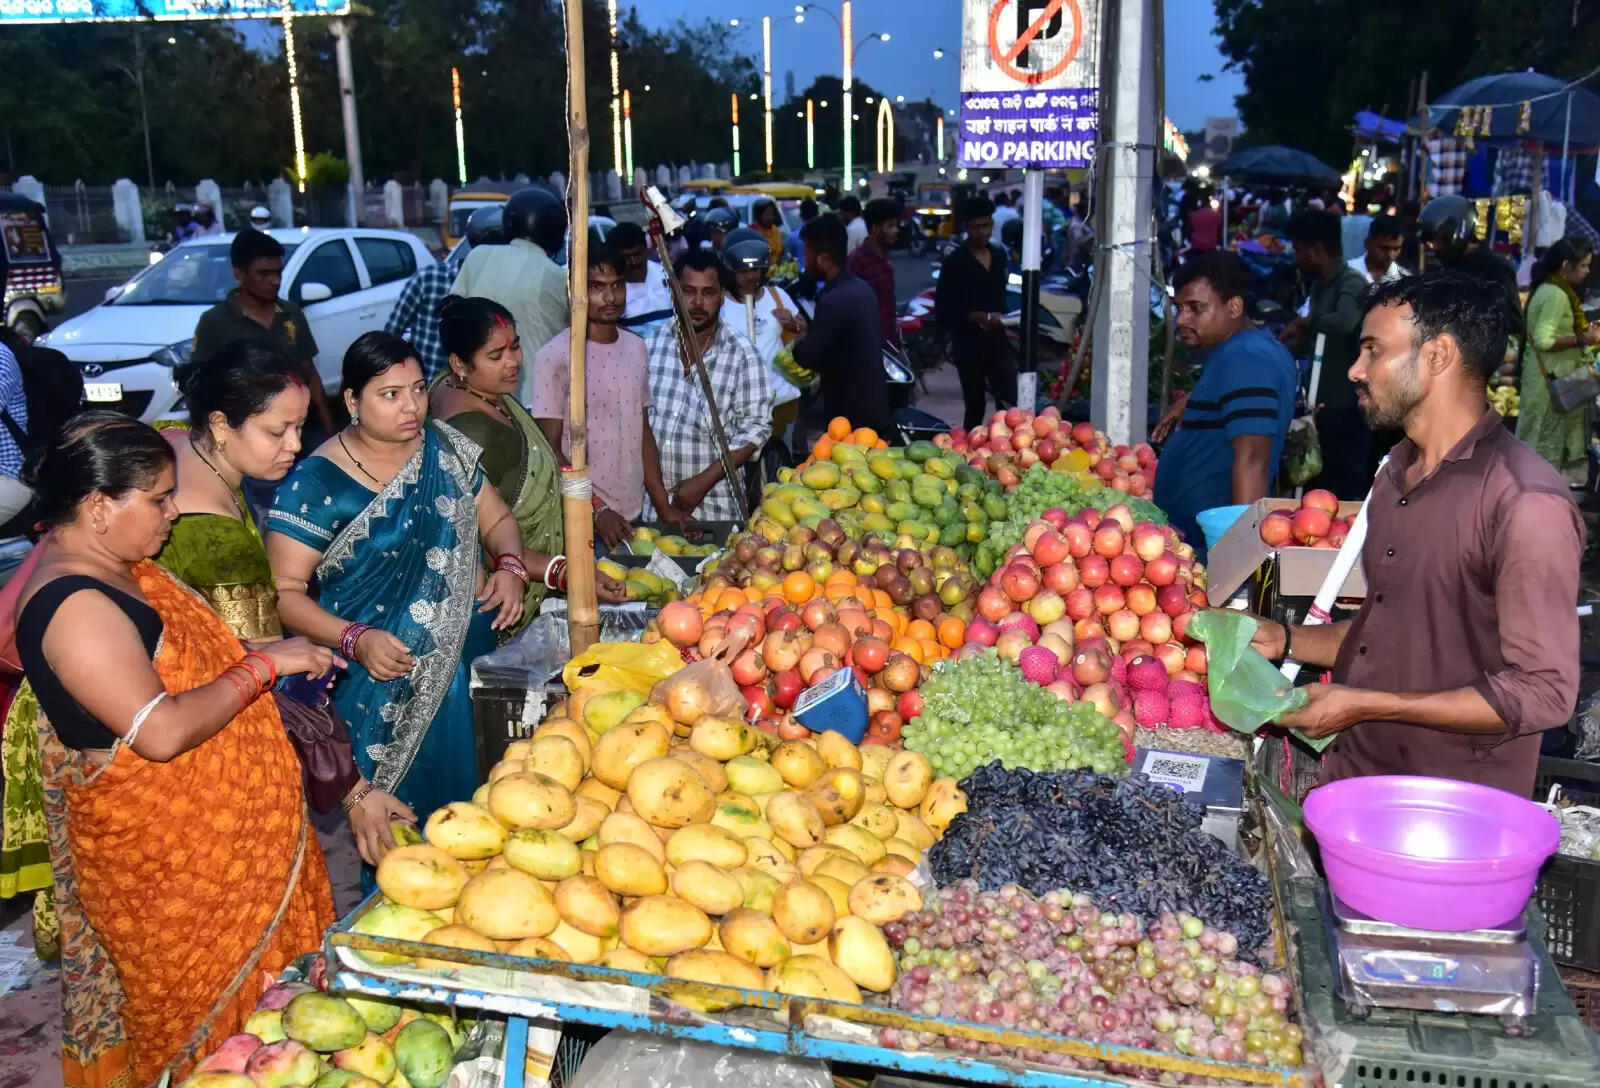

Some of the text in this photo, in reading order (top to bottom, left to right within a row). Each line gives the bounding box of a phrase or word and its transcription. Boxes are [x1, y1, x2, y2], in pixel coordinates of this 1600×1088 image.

[993, 119, 1027, 135] वाहन
[1030, 113, 1057, 132] पार्क
[1060, 117, 1073, 132] न
[964, 140, 1096, 161] NO PARKING
